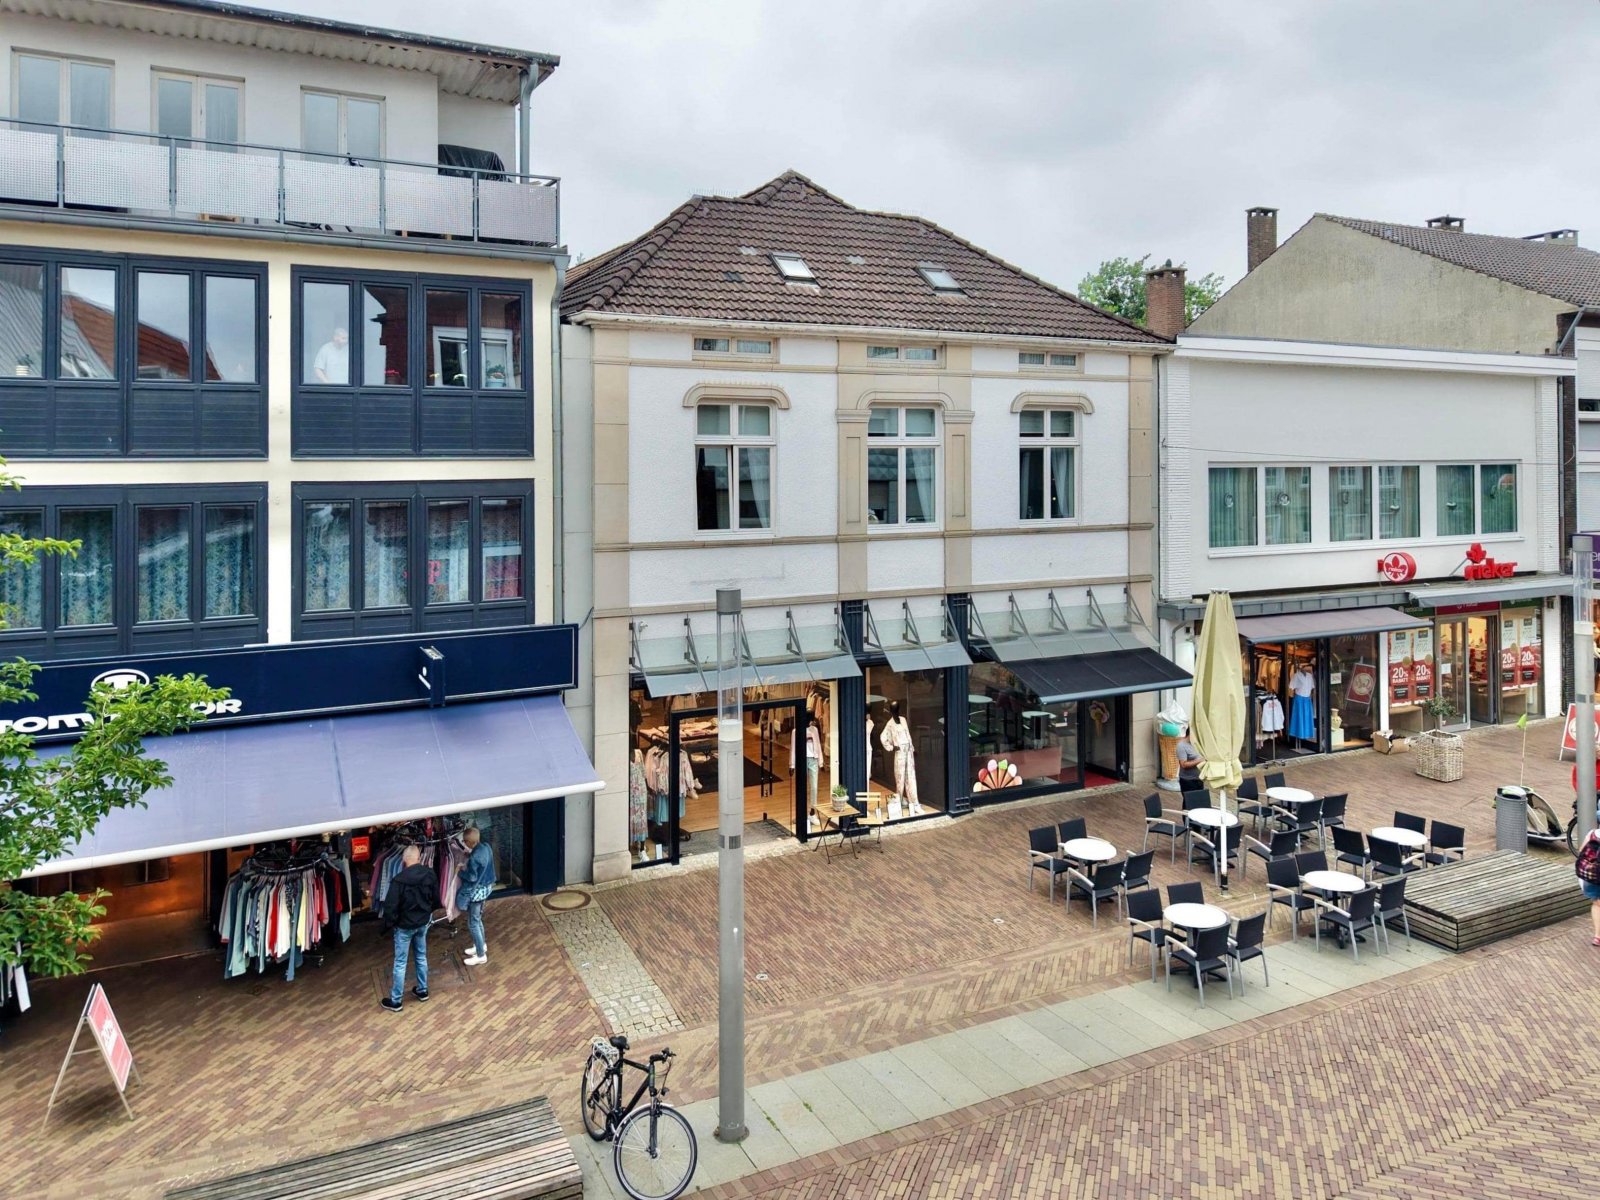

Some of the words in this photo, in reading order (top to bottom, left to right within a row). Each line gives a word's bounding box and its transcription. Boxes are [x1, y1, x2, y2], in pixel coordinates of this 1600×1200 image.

[1464, 558, 1517, 580] rieker
[1392, 667, 1409, 679] 20%
[1416, 664, 1431, 676] 20%
